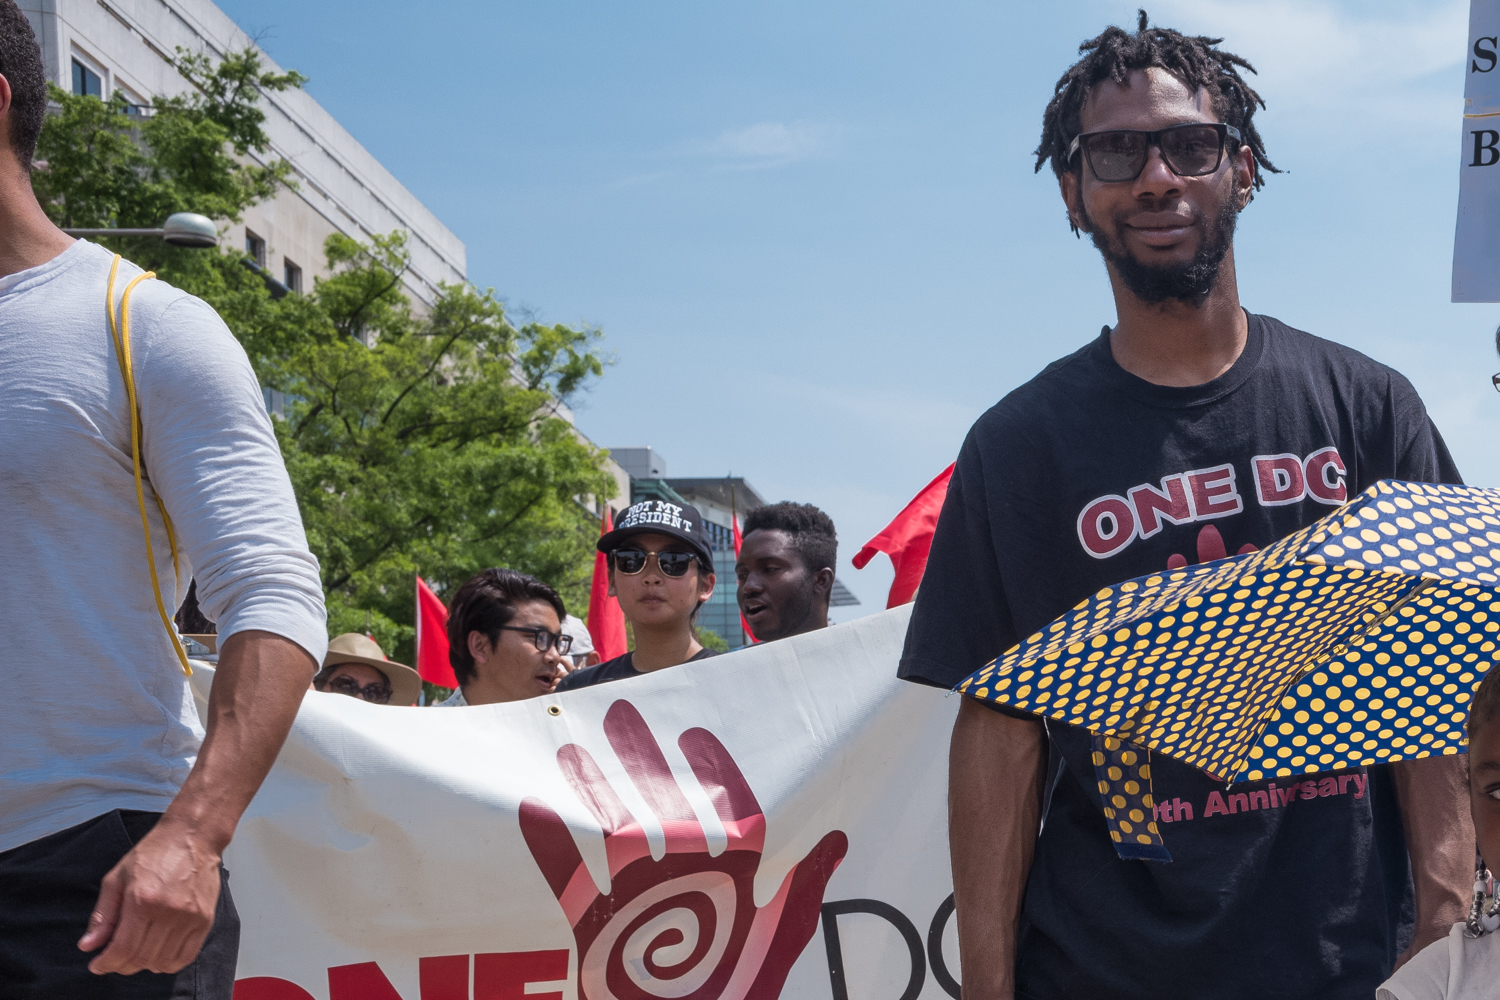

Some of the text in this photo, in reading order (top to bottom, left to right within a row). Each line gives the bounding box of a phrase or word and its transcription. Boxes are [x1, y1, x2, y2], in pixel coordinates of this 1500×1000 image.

[626, 500, 683, 518] NOT MY
[1077, 446, 1348, 558] ONE DC
[619, 511, 692, 532] PRESIDENT
